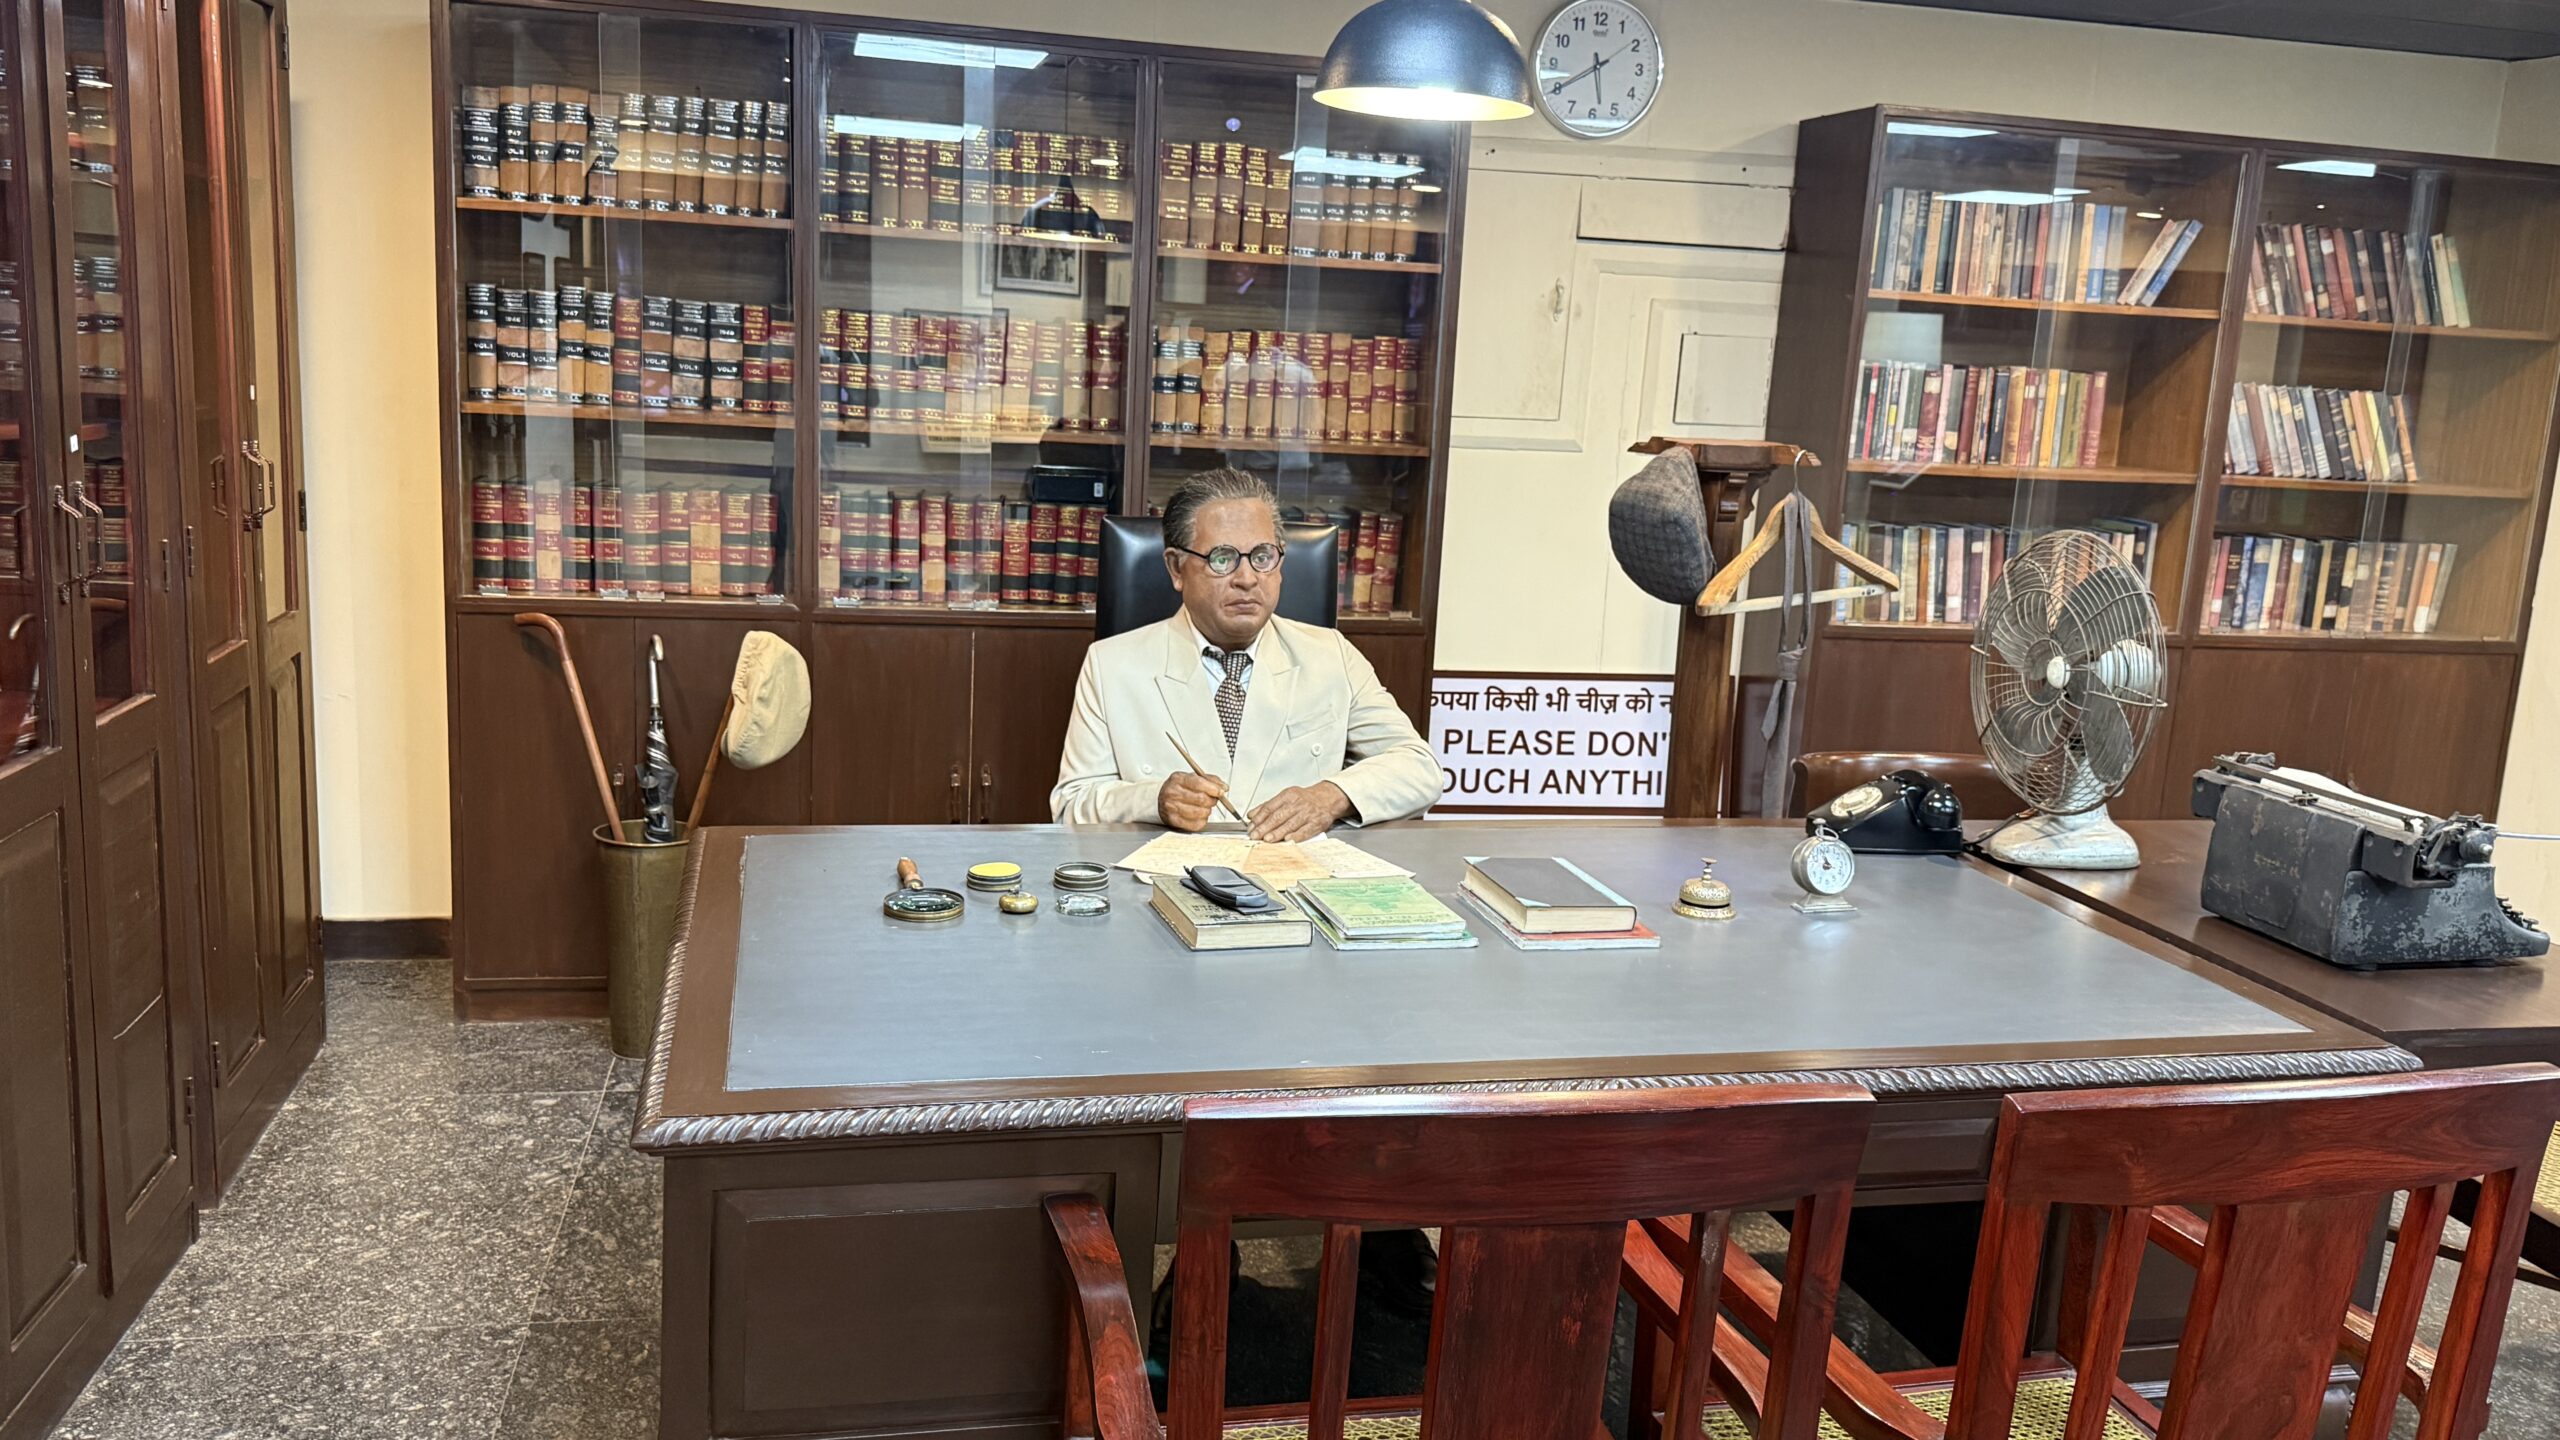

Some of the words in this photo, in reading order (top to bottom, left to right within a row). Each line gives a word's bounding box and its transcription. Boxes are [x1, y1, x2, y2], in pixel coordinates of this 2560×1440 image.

[1573, 17, 1586, 31] 11
[1594, 11, 1608, 26] 12
[1619, 20, 1625, 34] 1
[1555, 34, 1570, 48] 10
[1631, 39, 1640, 52] 2
[1549, 57, 1558, 70] 9
[1635, 63, 1644, 76] 3
[1553, 82, 1562, 95] 8
[1627, 86, 1636, 100] 4
[1568, 100, 1577, 114] 7
[1588, 108, 1597, 119] 6
[1610, 103, 1619, 116] 5
[1484, 686, 1540, 712] किसी
[1545, 687, 1570, 712] भी
[1575, 688, 1620, 714] चीज़
[1624, 687, 1655, 713] को
[1443, 729, 1575, 756] PLEASE
[1588, 731, 1670, 757] DON'
[1442, 767, 1529, 794] OUCH
[1539, 769, 1663, 796] ANYTHI
